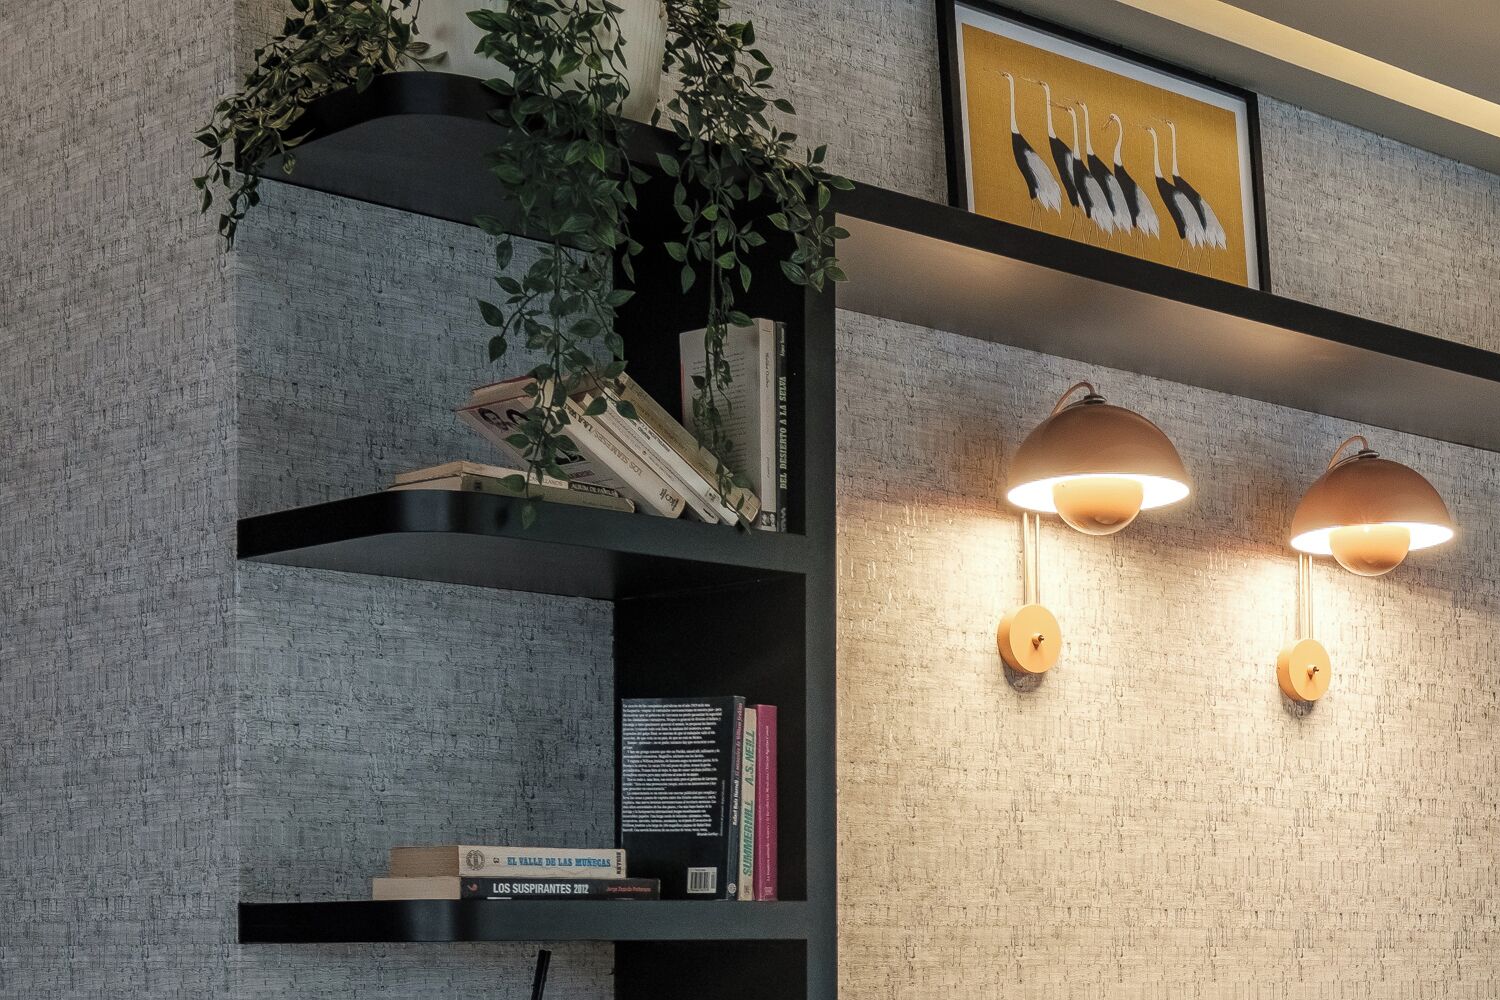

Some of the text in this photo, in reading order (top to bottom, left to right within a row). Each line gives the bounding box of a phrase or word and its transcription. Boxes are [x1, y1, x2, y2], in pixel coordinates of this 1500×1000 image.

[779, 376, 787, 401] SELVA
[779, 405, 787, 416] LA
[594, 431, 629, 464] SIAMESES
[779, 427, 787, 470] DESIERTO
[628, 463, 642, 476] LOS
[779, 473, 787, 490] DEL
[743, 800, 754, 876] SUMMERHILL
[507, 857, 611, 868] EL VALLE DE LAS MUÑECAS
[493, 883, 589, 895] LOS SUSPIRANTES 2012
